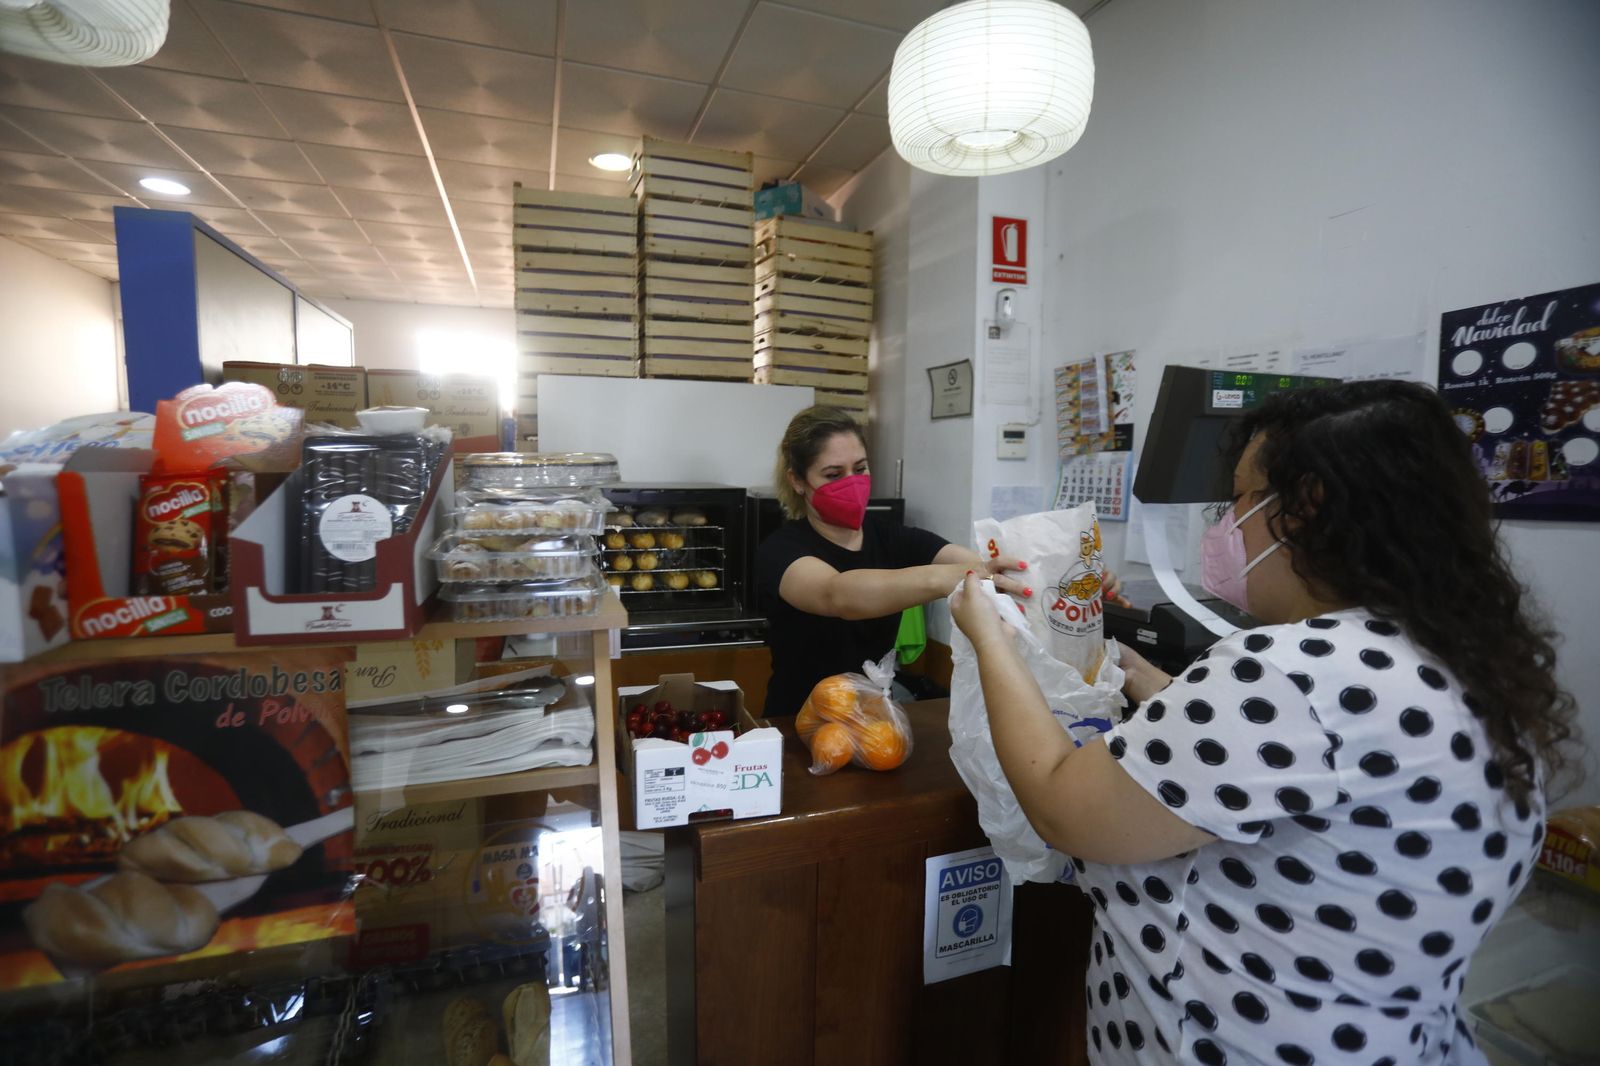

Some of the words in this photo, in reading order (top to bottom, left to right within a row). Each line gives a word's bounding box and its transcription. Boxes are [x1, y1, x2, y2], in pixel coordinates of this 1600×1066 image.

[1451, 300, 1558, 347] Navidad
[185, 395, 262, 425] nocilla
[148, 490, 204, 518] nocilla
[83, 596, 167, 637] nocilla
[39, 674, 156, 712] Telera
[164, 665, 343, 704] Cordobesa
[216, 703, 246, 729] de
[734, 764, 768, 773] Frutas
[366, 801, 467, 832] Tradicional
[940, 862, 999, 889] AVISO
[940, 893, 950, 902] ES
[951, 884, 999, 900] OBLIGATORIO
[962, 895, 976, 904] USO
[978, 892, 988, 900] DE
[939, 933, 994, 953] MASCARILLA
